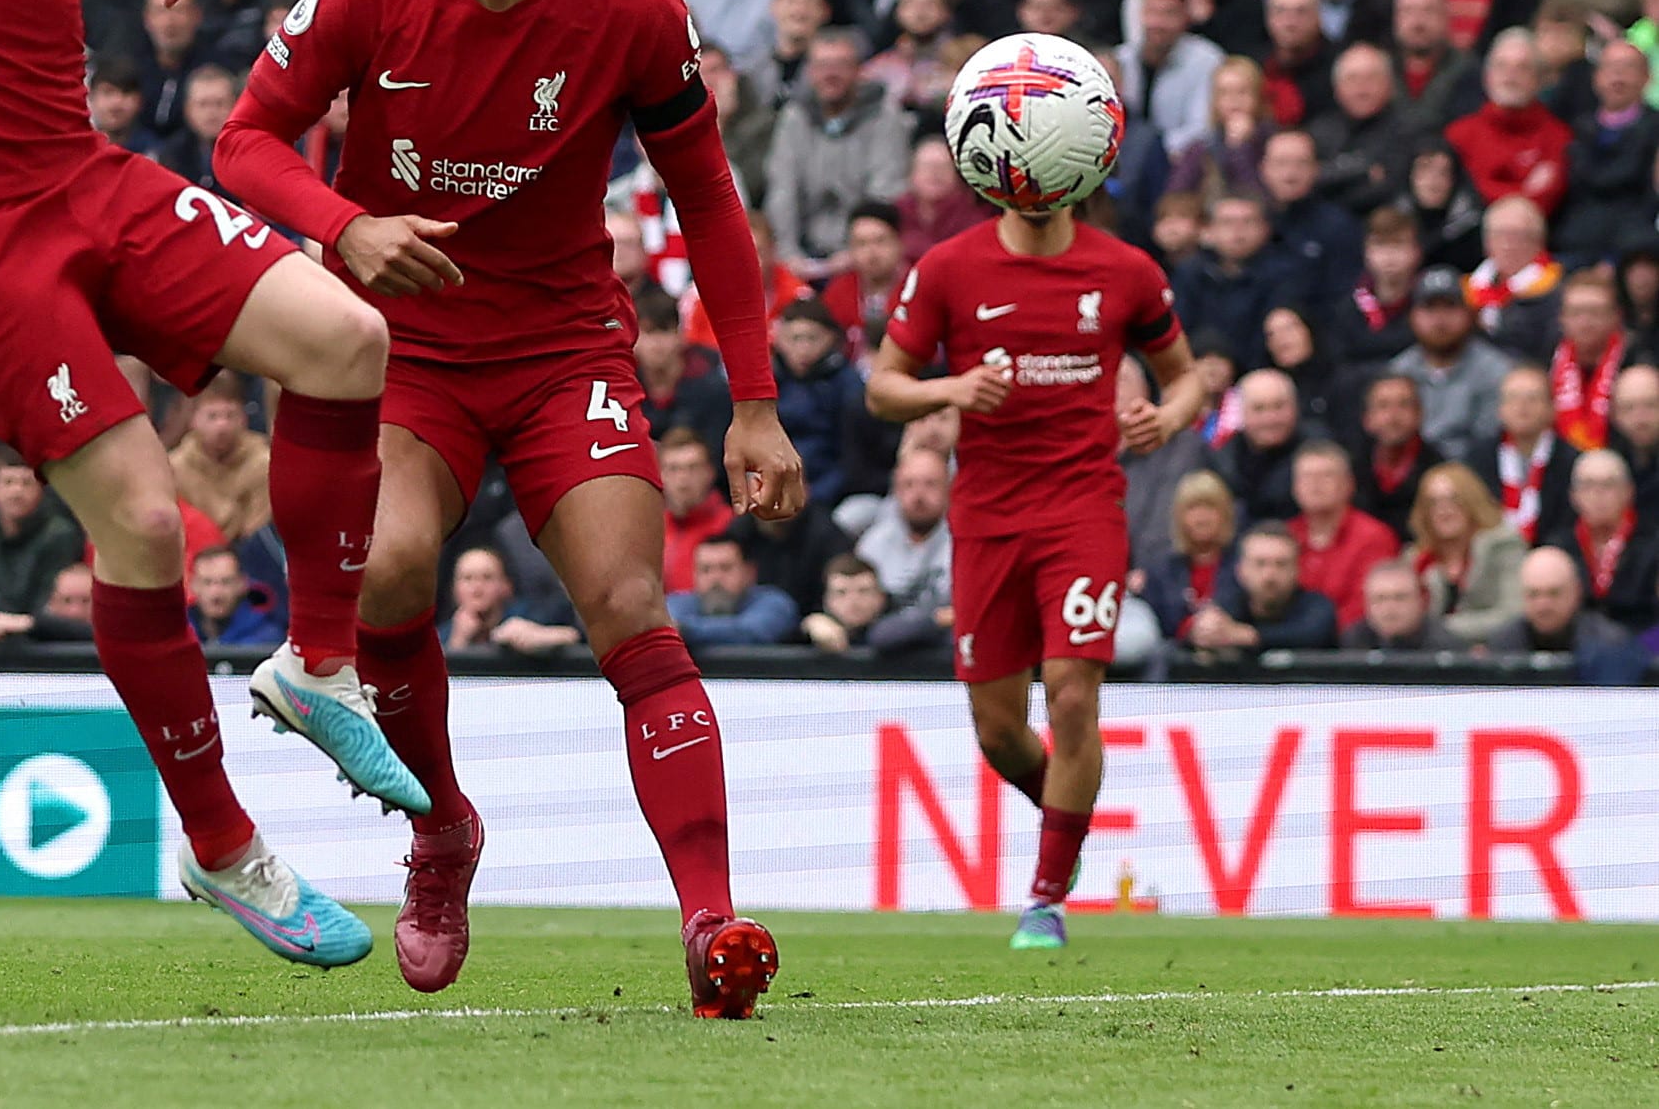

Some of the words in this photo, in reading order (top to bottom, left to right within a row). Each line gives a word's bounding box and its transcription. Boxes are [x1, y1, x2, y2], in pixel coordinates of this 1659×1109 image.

[529, 118, 559, 131] LFC
[430, 176, 519, 200] charter
[174, 185, 255, 247] 2
[586, 380, 628, 432] 4
[1062, 576, 1119, 629] 66
